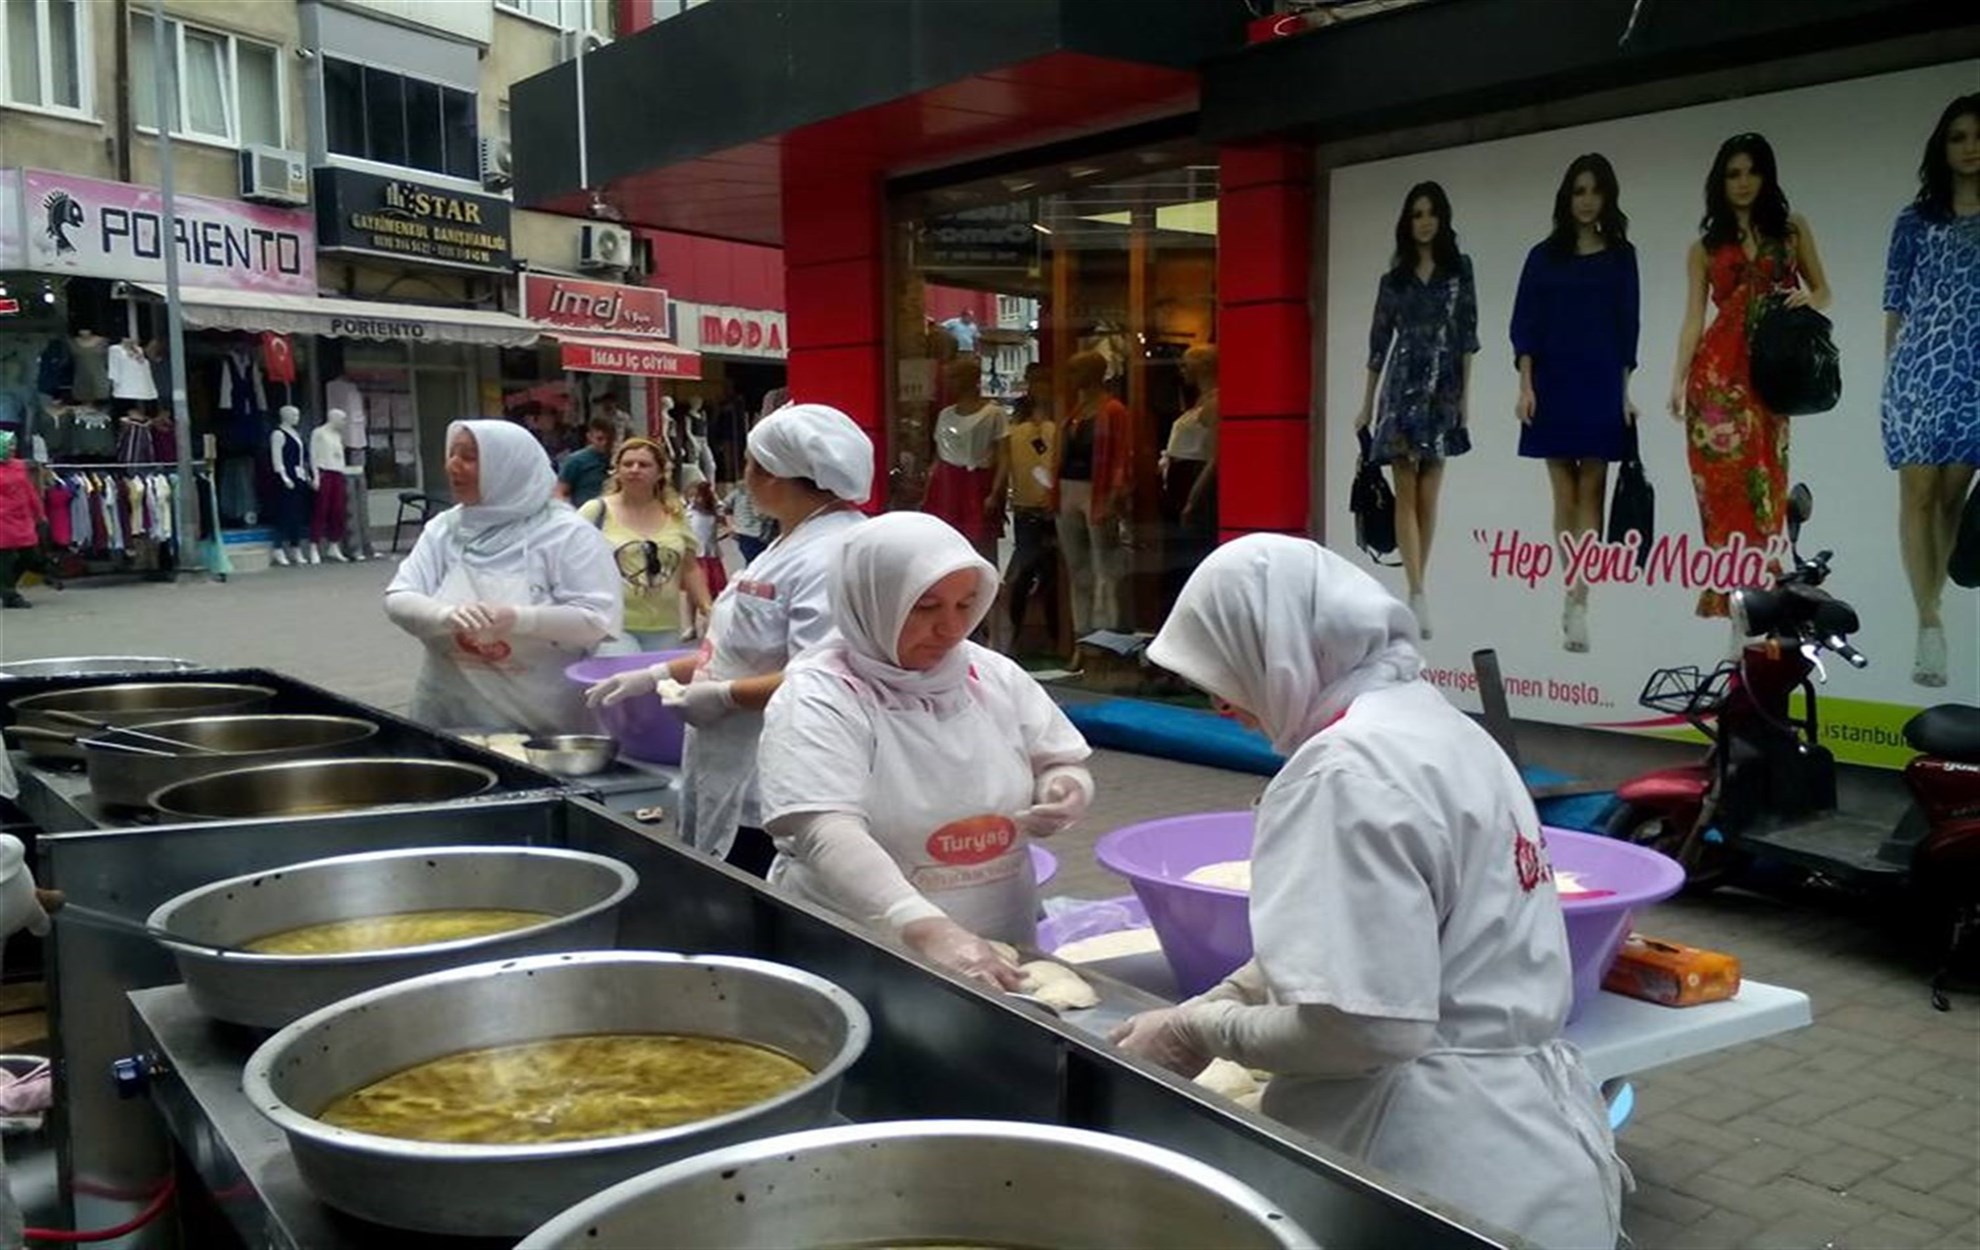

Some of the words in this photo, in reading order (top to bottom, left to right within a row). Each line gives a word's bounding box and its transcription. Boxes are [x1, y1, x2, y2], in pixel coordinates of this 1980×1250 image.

[414, 193, 482, 224] STAR
[100, 207, 300, 275] PORIENTO
[702, 314, 783, 350] MODA
[1563, 529, 1638, 586] Yeni
[937, 831, 1010, 853] Turyağ
